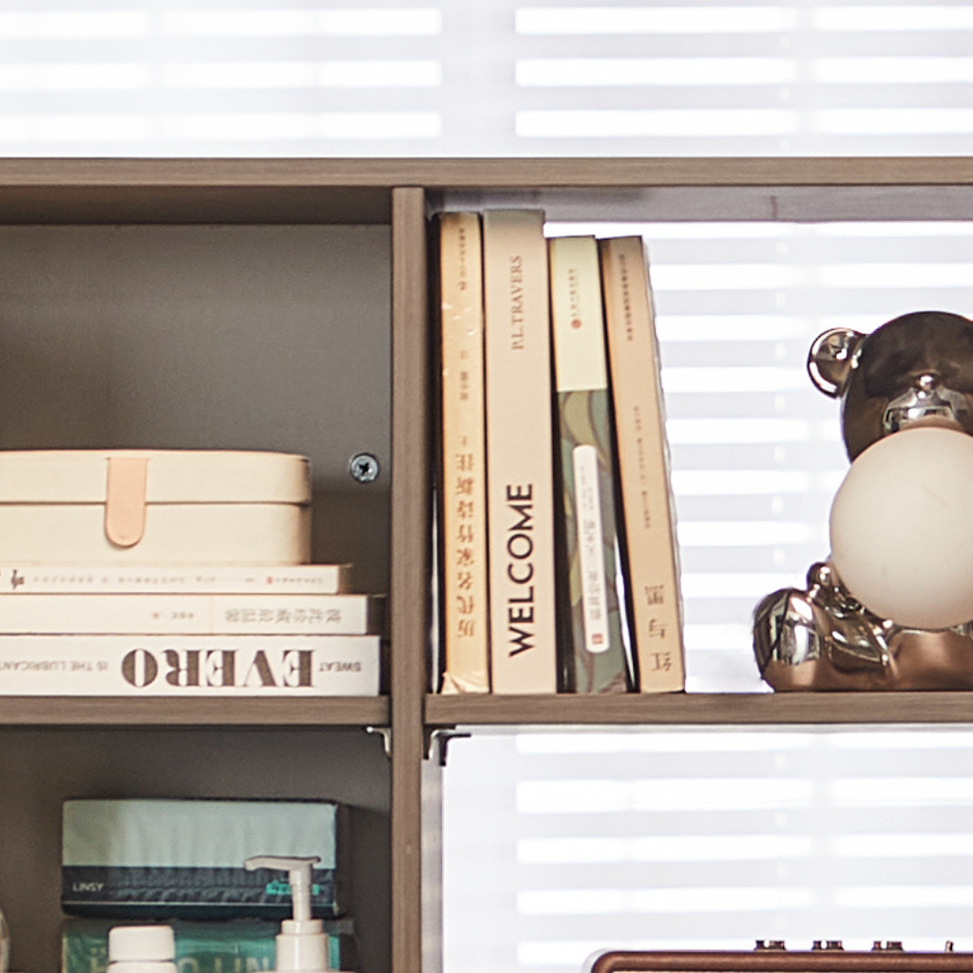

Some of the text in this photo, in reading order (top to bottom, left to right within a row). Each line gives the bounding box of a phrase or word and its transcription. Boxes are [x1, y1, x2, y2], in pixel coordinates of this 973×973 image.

[455, 452, 475, 639] 历代名家竹诗新注
[505, 484, 534, 658] WELCOME
[644, 584, 674, 672] 红与黑
[70, 660, 93, 672] THE
[96, 660, 109, 672] IS
[120, 648, 315, 688] EVERO
[319, 660, 363, 673] SWEAT
[72, 882, 105, 893] LINSY
